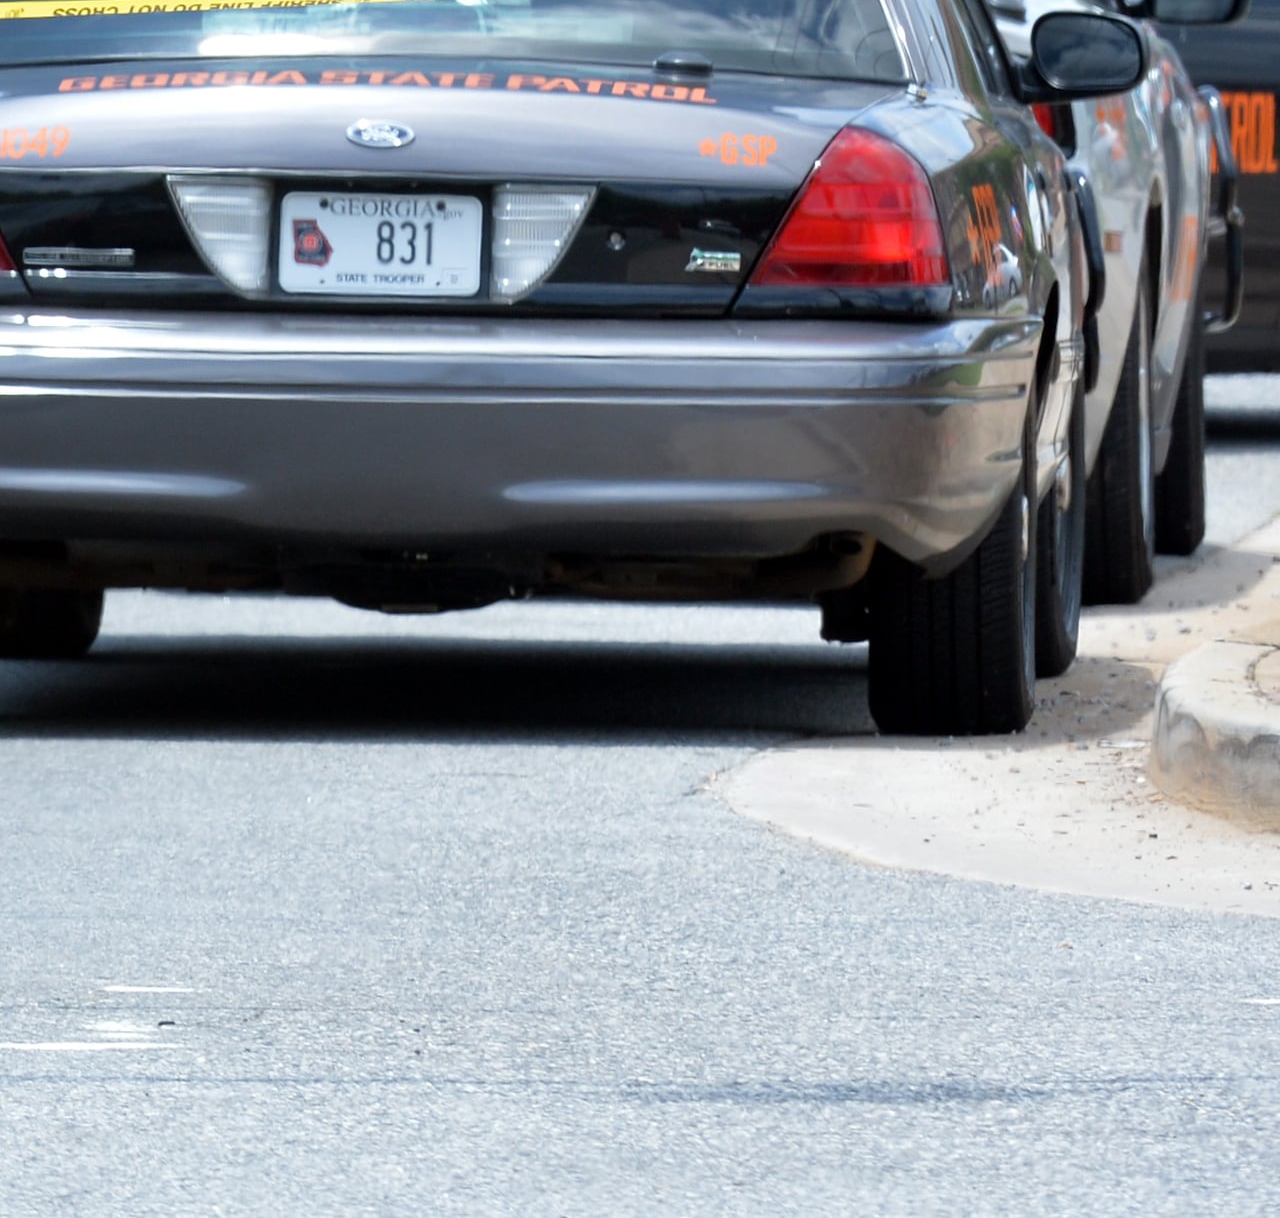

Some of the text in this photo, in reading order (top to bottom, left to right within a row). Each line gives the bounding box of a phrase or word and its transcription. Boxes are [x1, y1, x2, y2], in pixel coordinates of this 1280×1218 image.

[57, 70, 718, 105] GEORGIA STATE PATROL
[720, 133, 778, 168] GSP
[329, 197, 437, 218] GEORGIA
[376, 220, 434, 267] 831
[336, 272, 425, 285] STATE TROOPER
